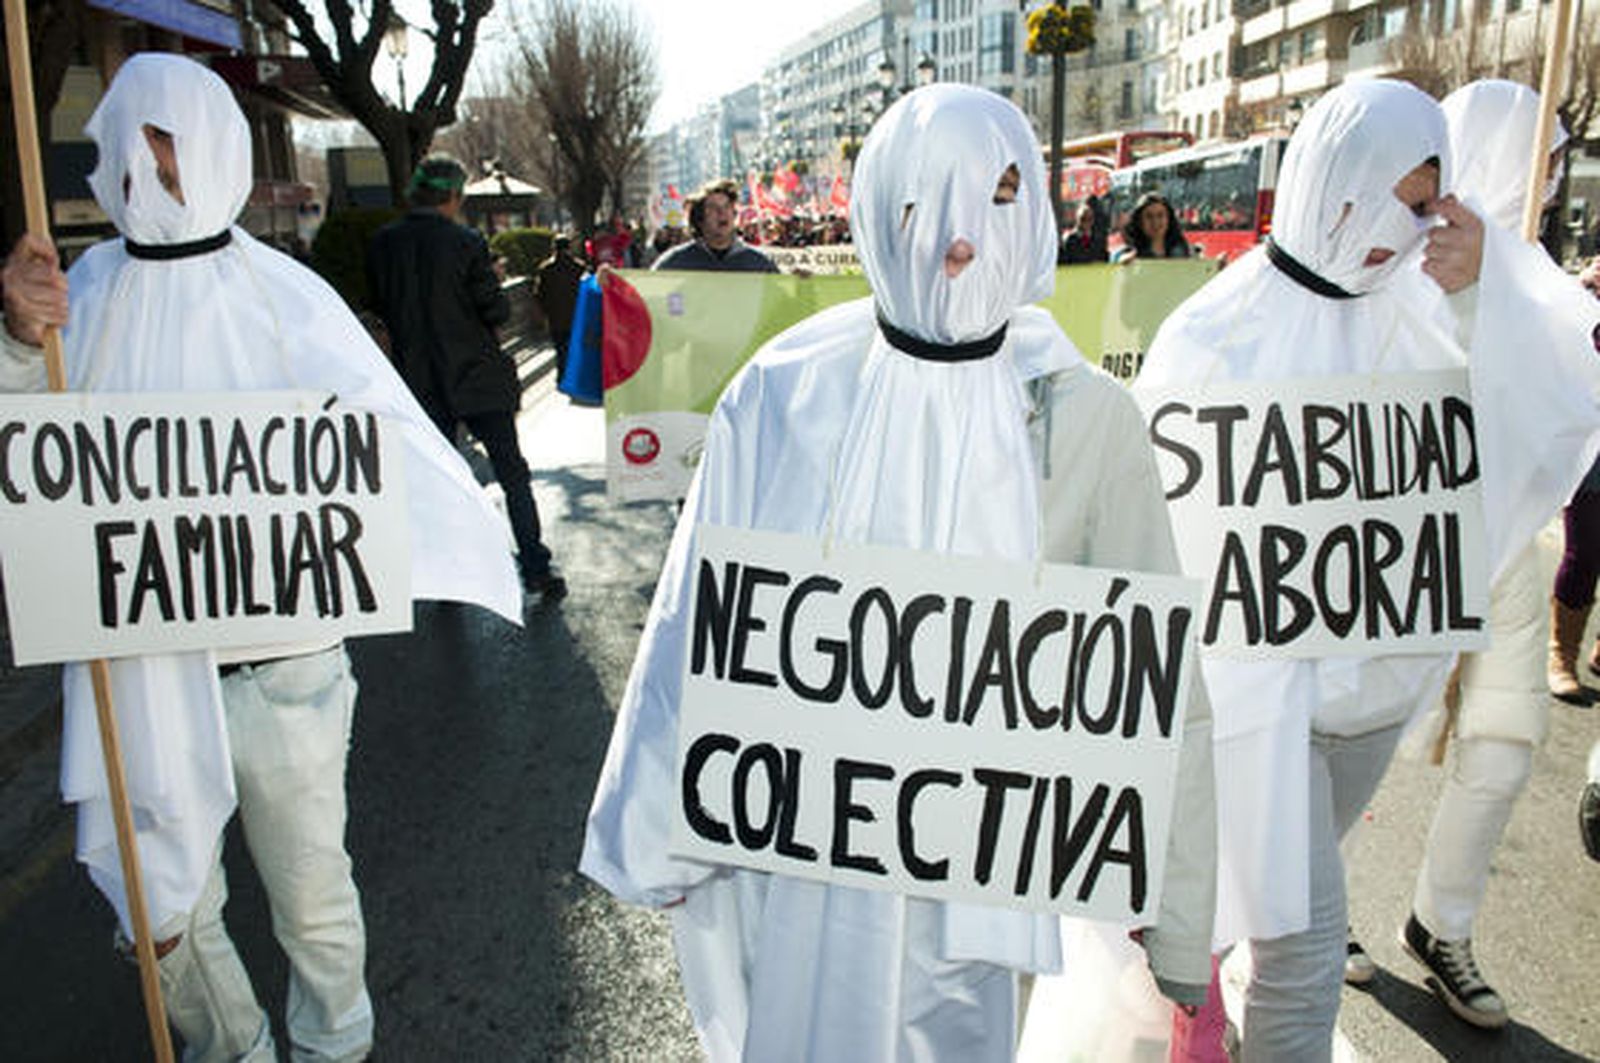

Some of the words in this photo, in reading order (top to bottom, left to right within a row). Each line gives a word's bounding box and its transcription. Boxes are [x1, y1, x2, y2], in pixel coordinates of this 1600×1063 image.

[0, 394, 382, 505] CONCILIACIÓN
[1150, 396, 1480, 507] STABILIDAD
[95, 502, 378, 629] FAMILIAR
[1203, 512, 1485, 646] ABORAL
[691, 558, 1192, 738] NEGOCIACIÓN
[682, 732, 1147, 914] COLECTIVA
